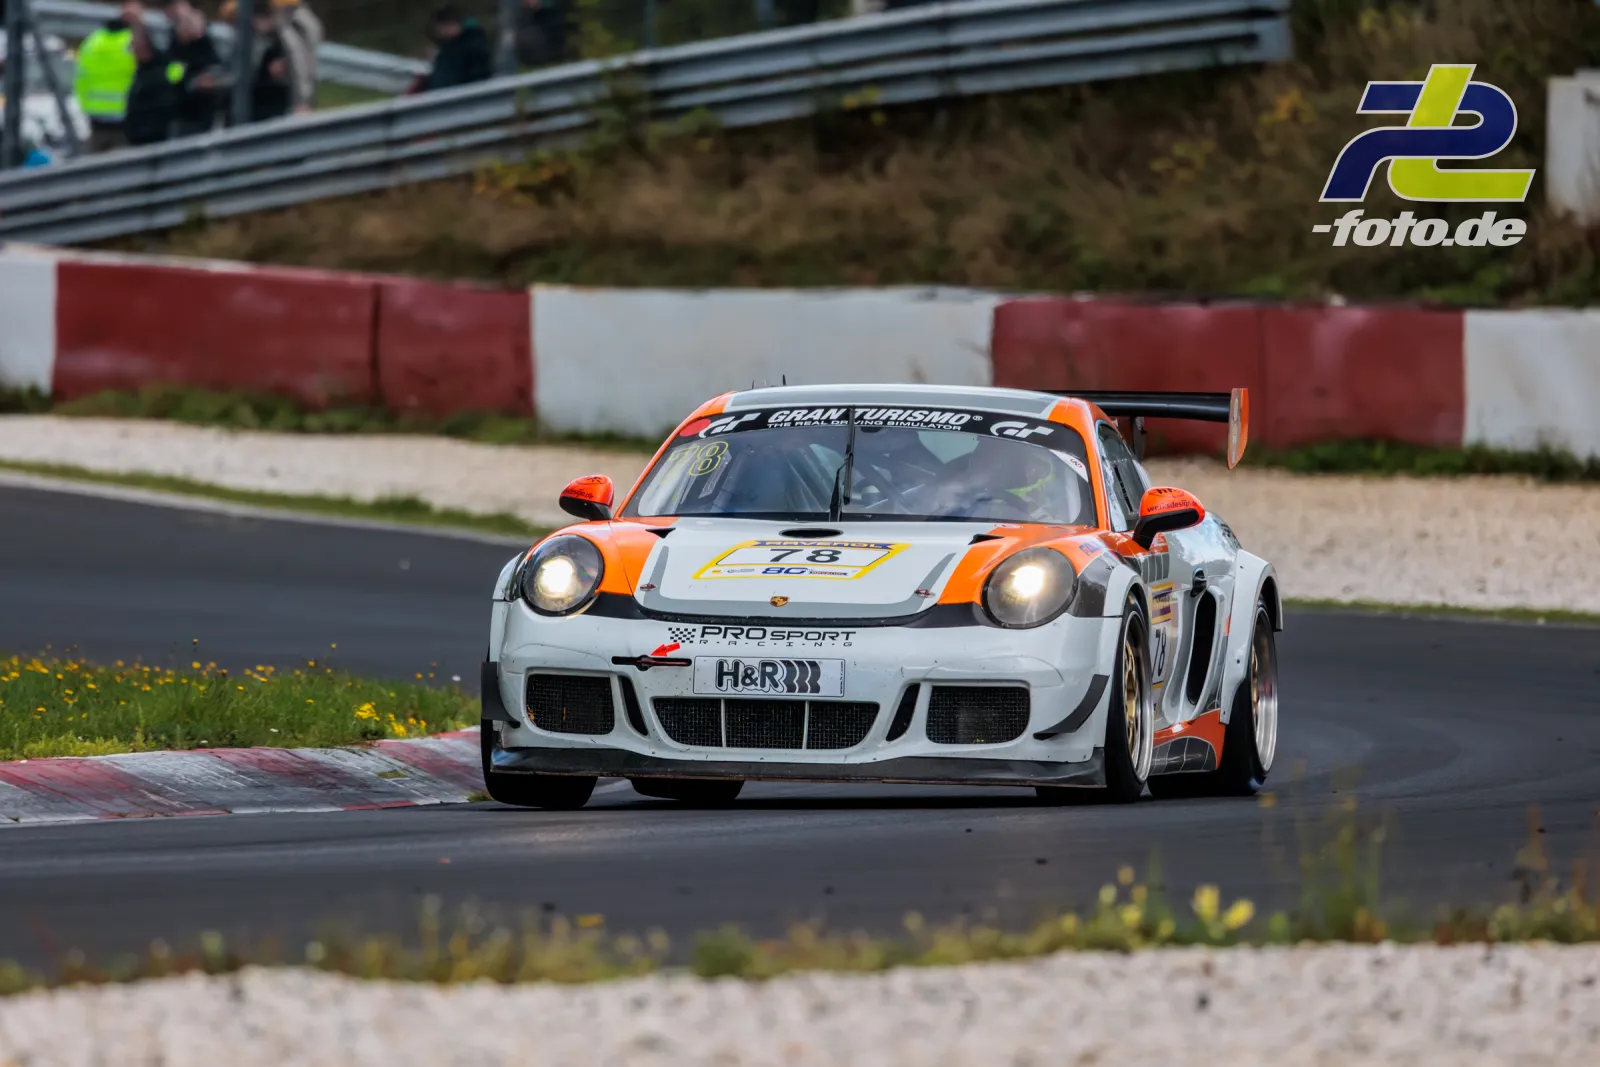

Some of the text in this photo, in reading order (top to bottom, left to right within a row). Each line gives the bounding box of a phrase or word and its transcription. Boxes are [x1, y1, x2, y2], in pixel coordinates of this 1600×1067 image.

[767, 408, 971, 425] GRAN TURISMO
[887, 421, 962, 431] SIMULATOR
[661, 441, 729, 483] 78
[769, 548, 842, 563] 78
[700, 625, 856, 641] PRO SPORT
[1152, 626, 1167, 678] 78
[716, 660, 783, 691] H&R
